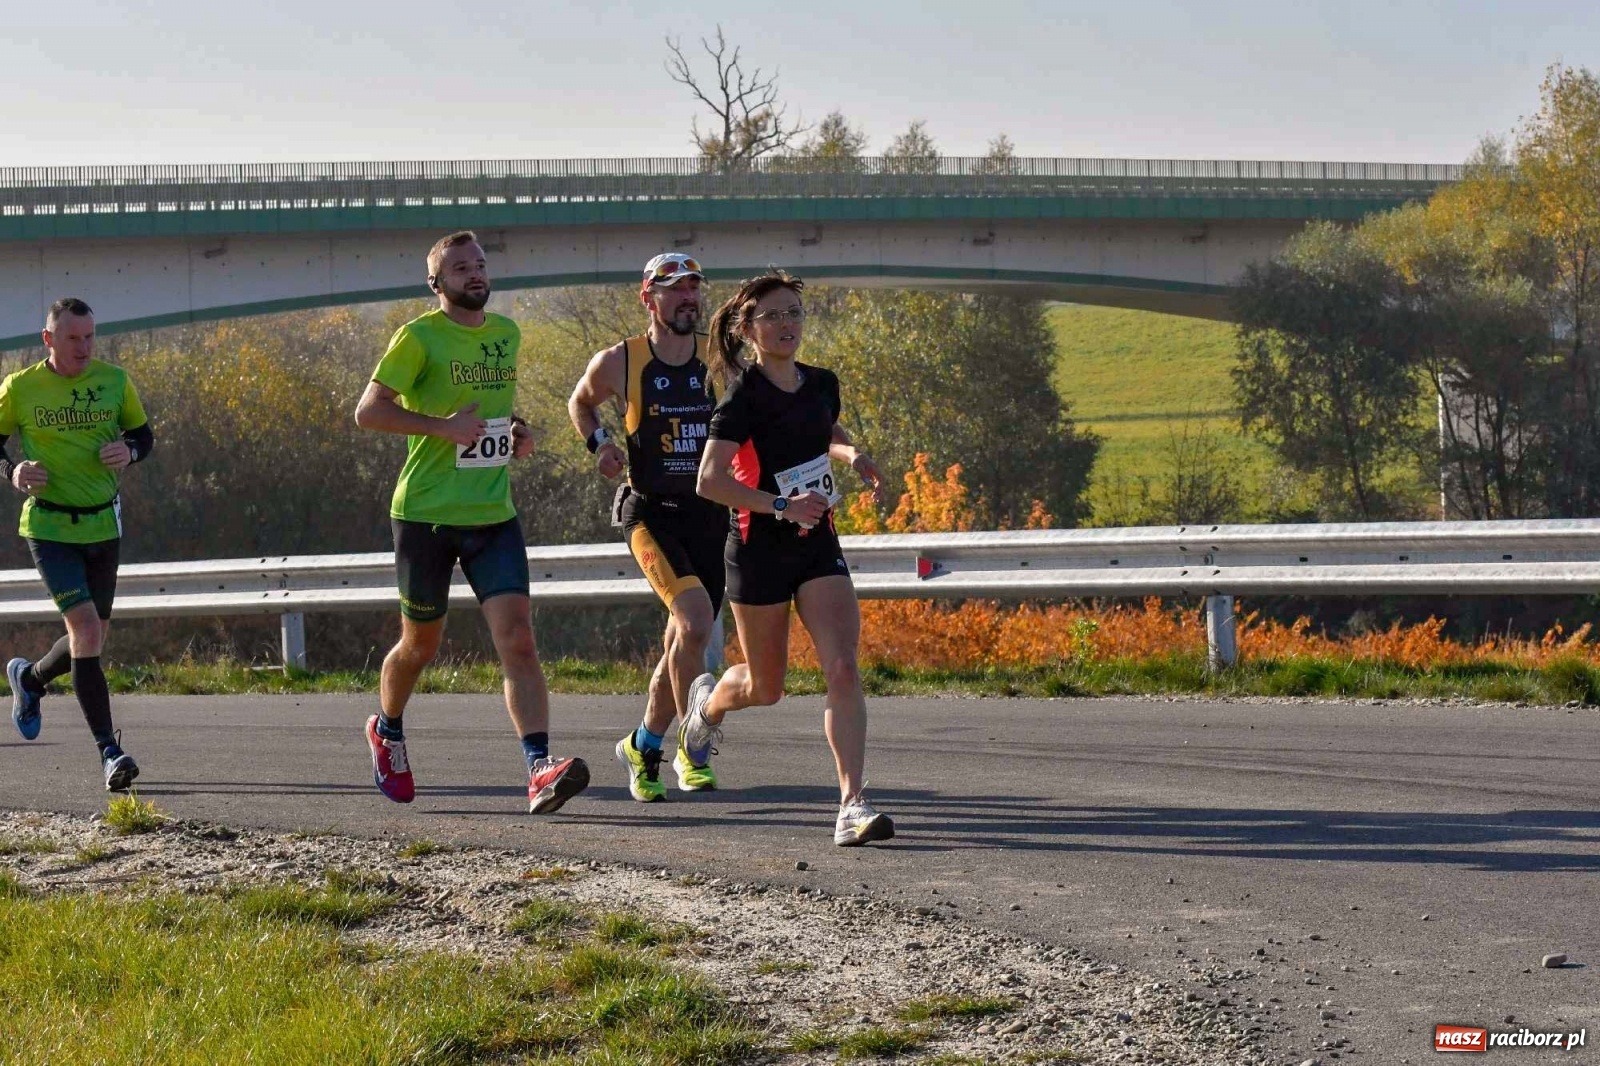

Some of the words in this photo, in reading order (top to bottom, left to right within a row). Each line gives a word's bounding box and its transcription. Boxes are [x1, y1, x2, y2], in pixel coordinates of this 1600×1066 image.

[668, 418, 707, 438] TEAM
[460, 434, 509, 459] 208
[660, 433, 697, 453] SAAR
